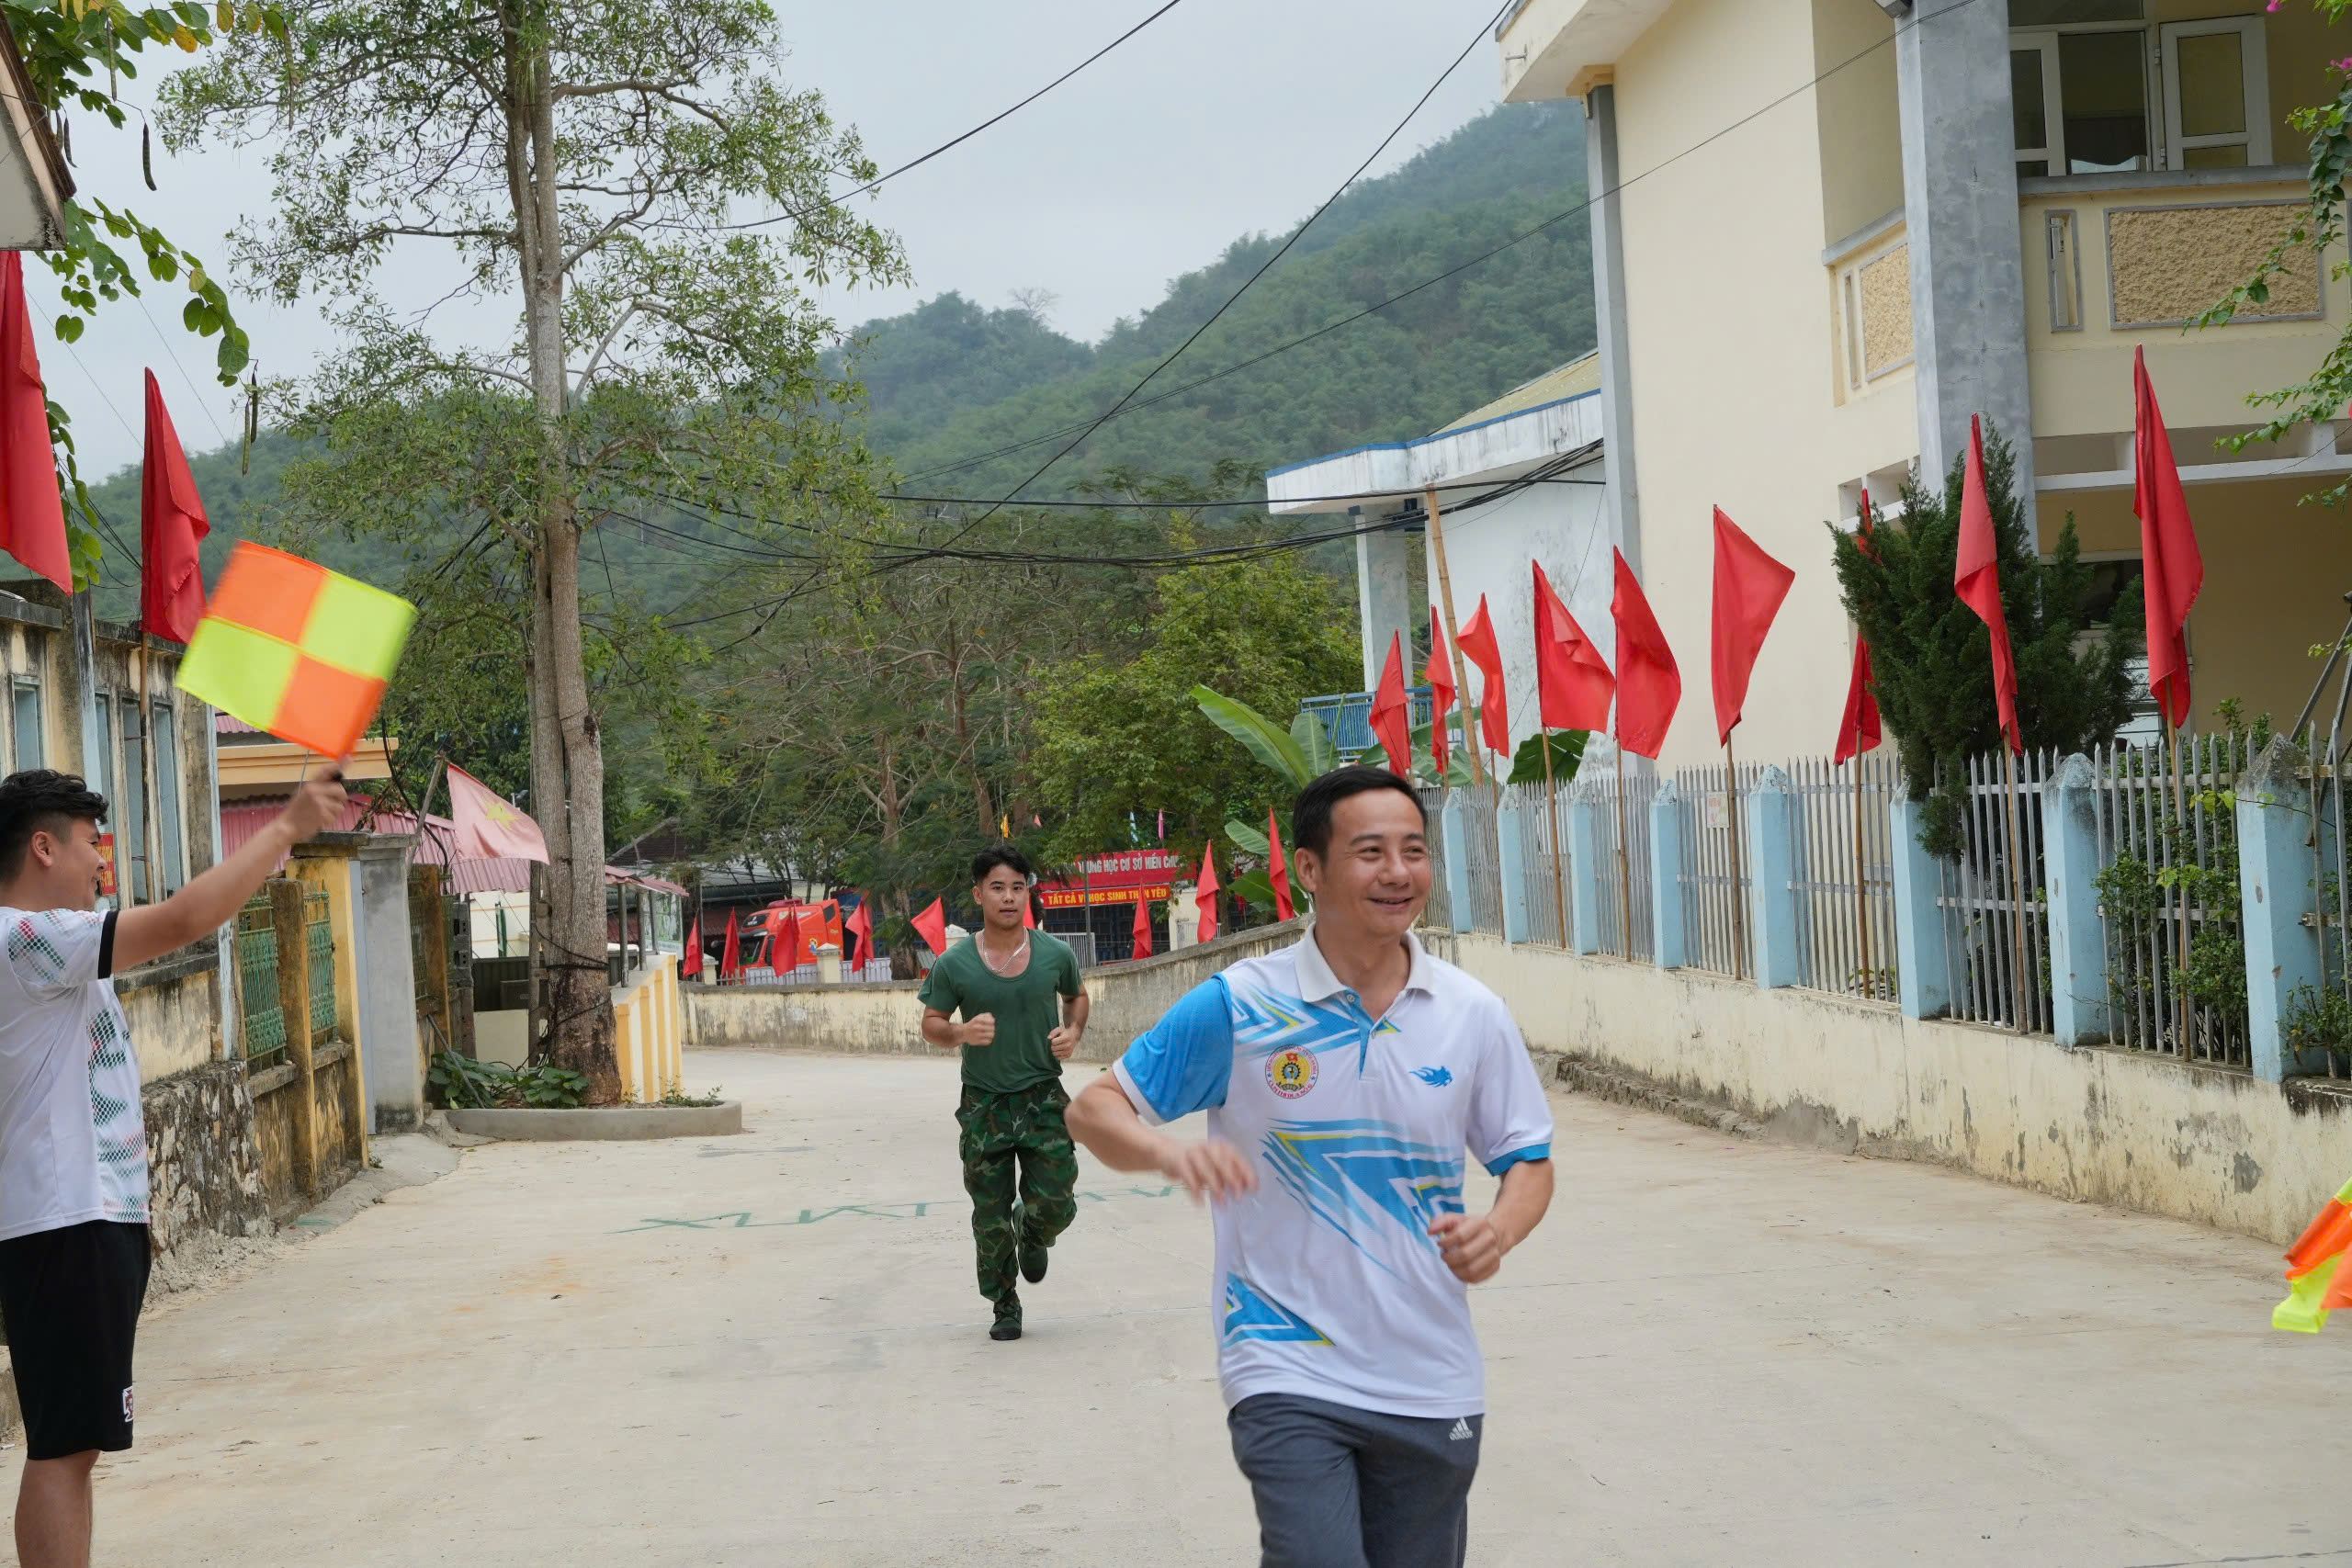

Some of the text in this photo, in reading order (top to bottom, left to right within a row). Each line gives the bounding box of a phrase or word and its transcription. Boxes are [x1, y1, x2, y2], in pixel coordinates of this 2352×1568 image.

[1107, 890, 1126, 901] SINH
[1128, 888, 1149, 900] THN
[1150, 886, 1167, 898] YÊU
